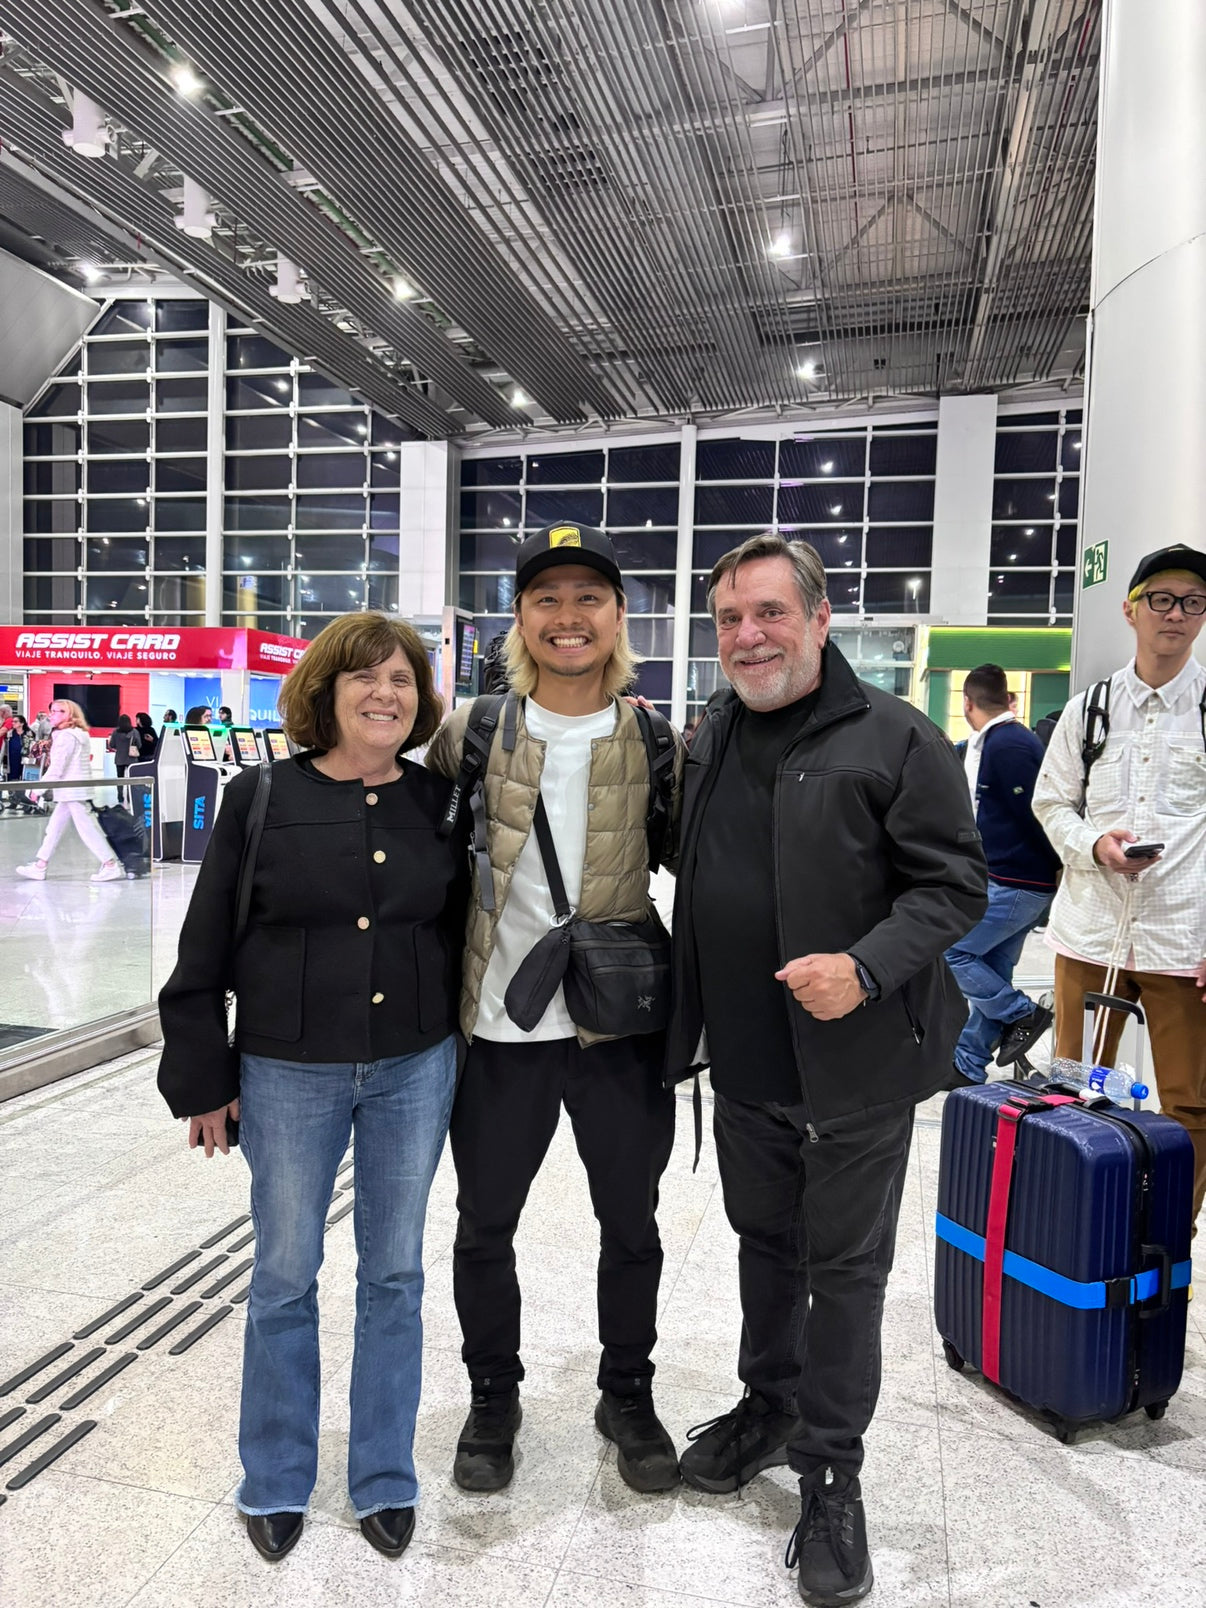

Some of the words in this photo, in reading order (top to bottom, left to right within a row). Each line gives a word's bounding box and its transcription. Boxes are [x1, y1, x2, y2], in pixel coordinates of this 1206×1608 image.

[15, 633, 109, 649] ASSIST
[110, 633, 181, 650] CARD
[259, 642, 294, 658] ASSIST
[15, 650, 41, 658] VIAJE
[44, 650, 103, 660] TRANQUILO,
[106, 651, 133, 660] VIAJE
[136, 651, 177, 660] SEGURO
[446, 784, 461, 823] MILLET
[193, 796, 206, 830] SITA
